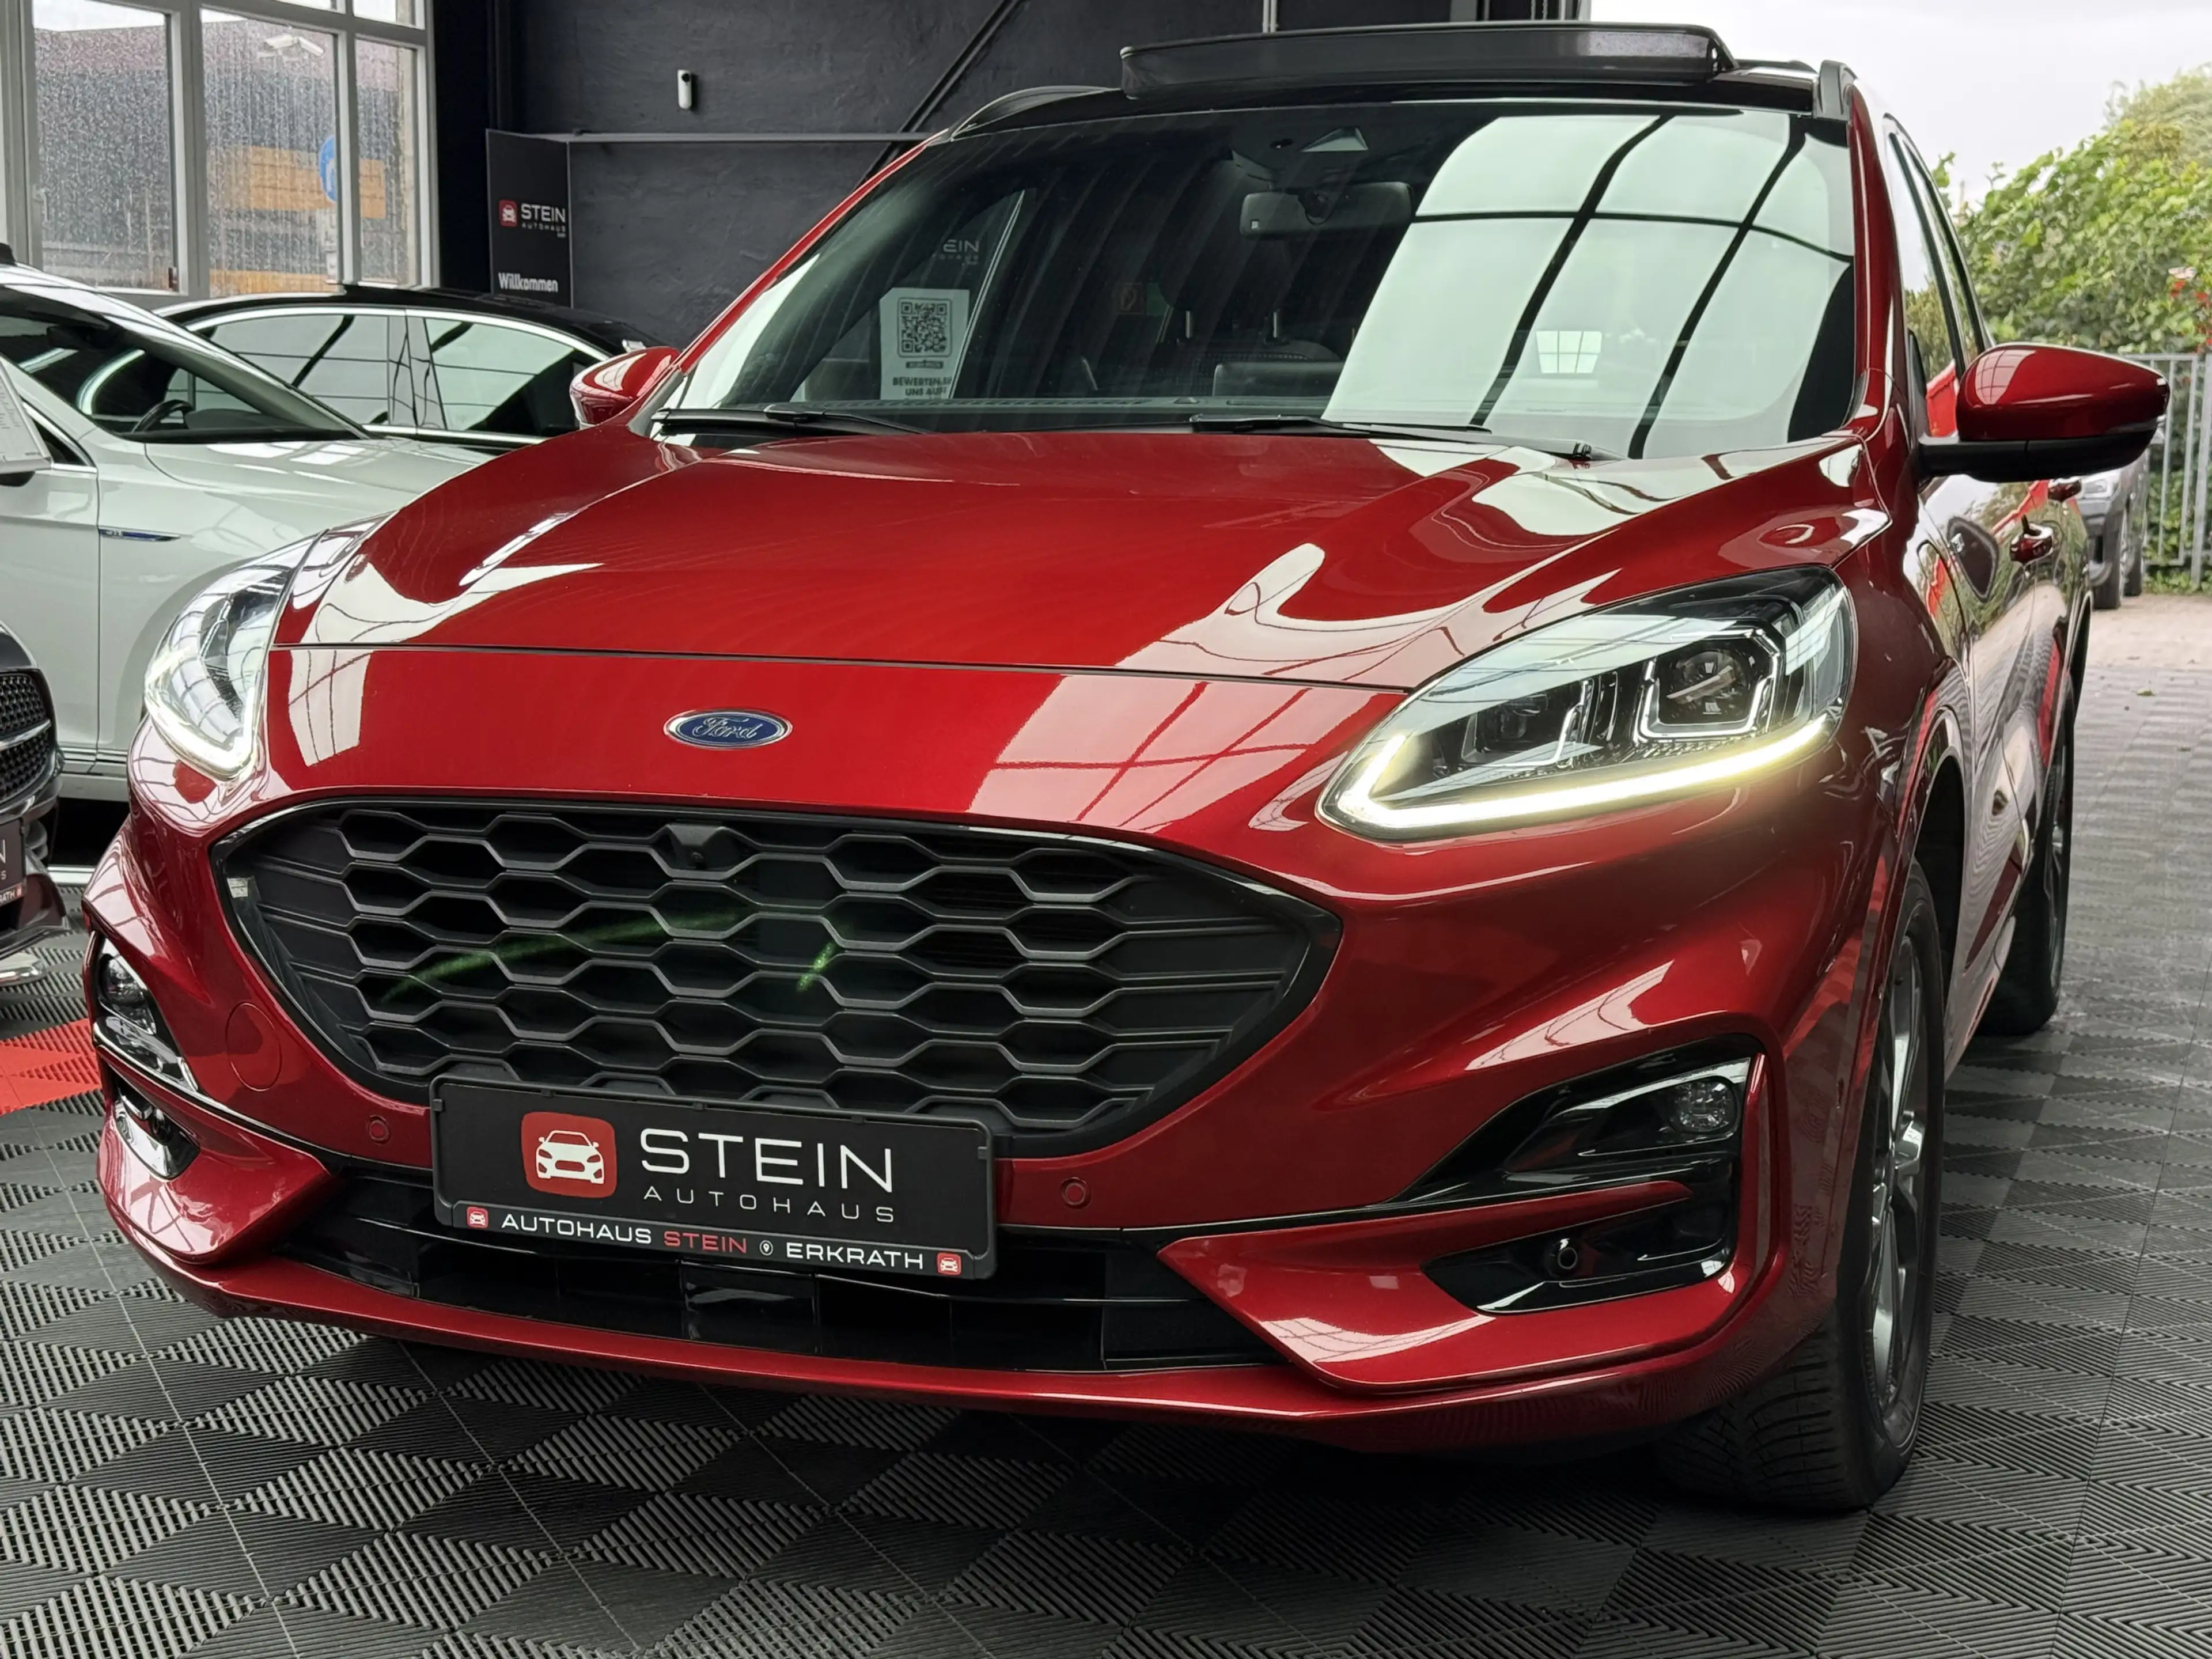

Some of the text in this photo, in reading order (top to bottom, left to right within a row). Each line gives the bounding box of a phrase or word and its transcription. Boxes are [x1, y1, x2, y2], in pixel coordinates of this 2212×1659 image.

[521, 203, 566, 223] STEIN
[522, 222, 566, 232] AUTOHAUS
[498, 272, 558, 293] Willkommen
[893, 377, 940, 386] BEWERTEN
[905, 388, 923, 396] UNS
[692, 717, 763, 739] Ford
[640, 1128, 893, 1193] STEIN
[643, 1185, 895, 1224] AUTOHAUS
[501, 1213, 924, 1271] AUTOHAUS STEIN ERKRATH
